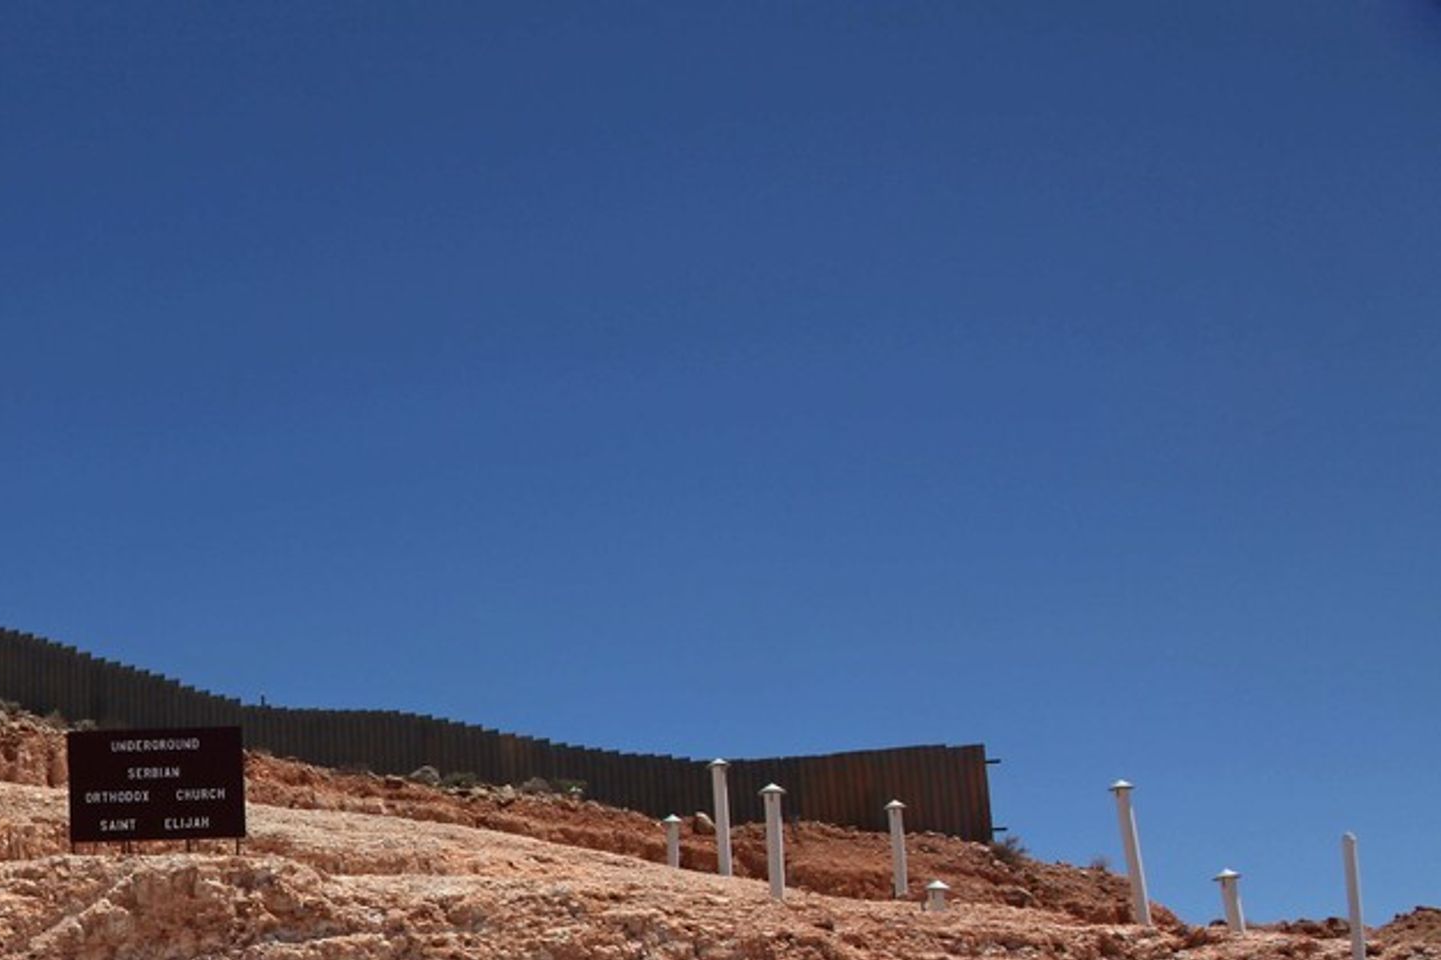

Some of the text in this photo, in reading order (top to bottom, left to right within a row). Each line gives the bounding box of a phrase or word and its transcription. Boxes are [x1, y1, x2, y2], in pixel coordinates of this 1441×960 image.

[110, 737, 200, 753] UNDERGROUND
[127, 766, 181, 780] SERBIAN
[85, 787, 226, 804] ORTHODOX CHURCH
[99, 816, 210, 831] SAINT ELIJAH
